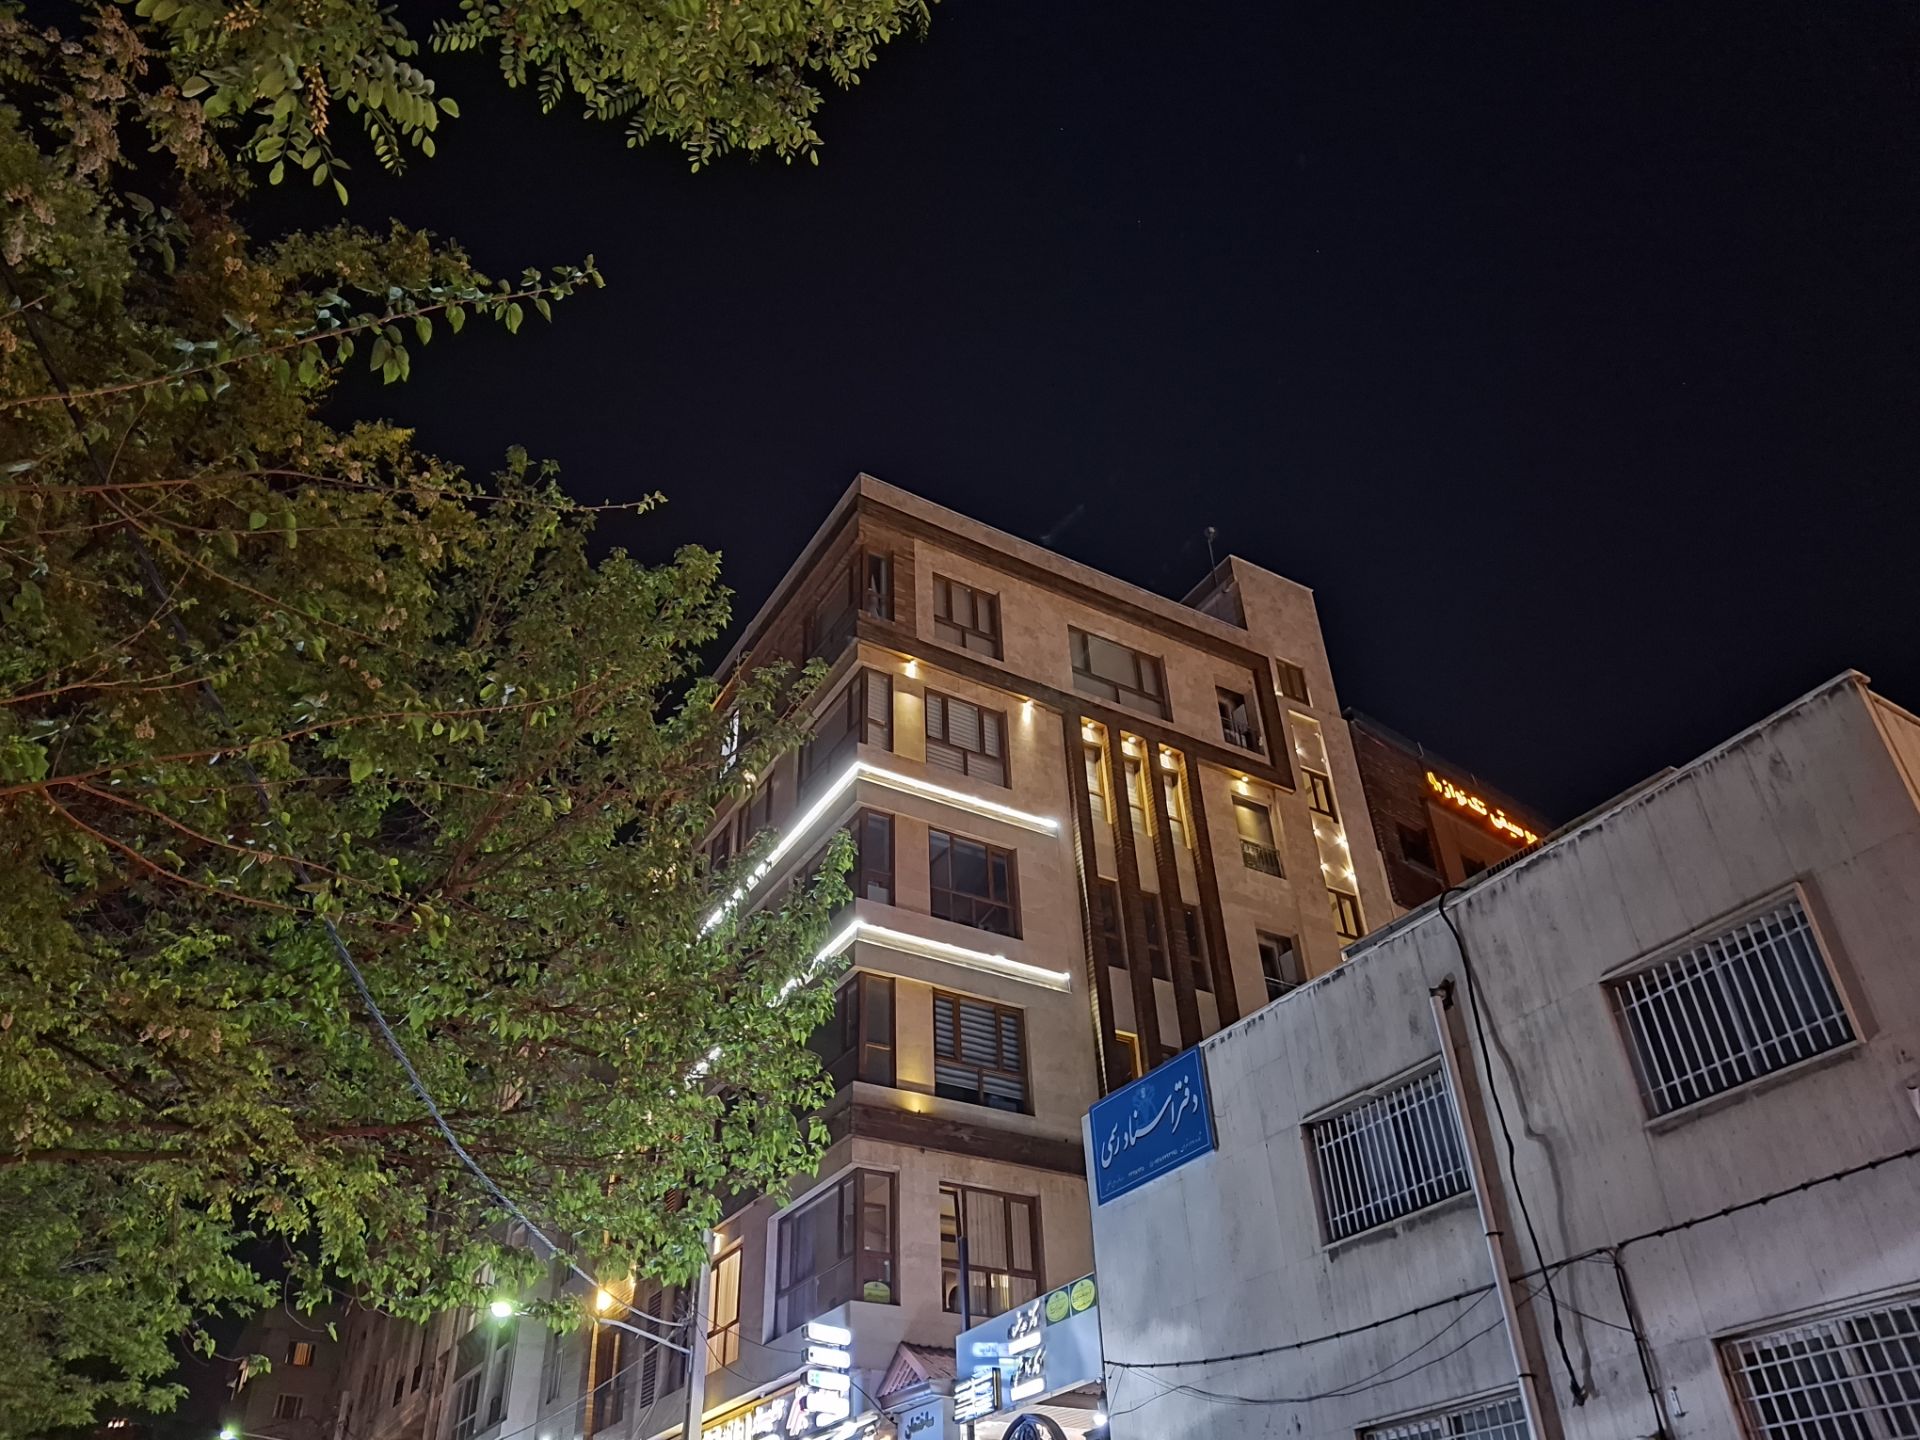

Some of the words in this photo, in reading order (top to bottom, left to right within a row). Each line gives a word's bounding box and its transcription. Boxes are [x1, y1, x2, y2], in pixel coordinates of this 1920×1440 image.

[1123, 1094, 1175, 1150] اسناد
[1171, 1074, 1198, 1133] دفتر
[1101, 1122, 1120, 1168] رسمی
[905, 1411, 934, 1440] ساختمان
